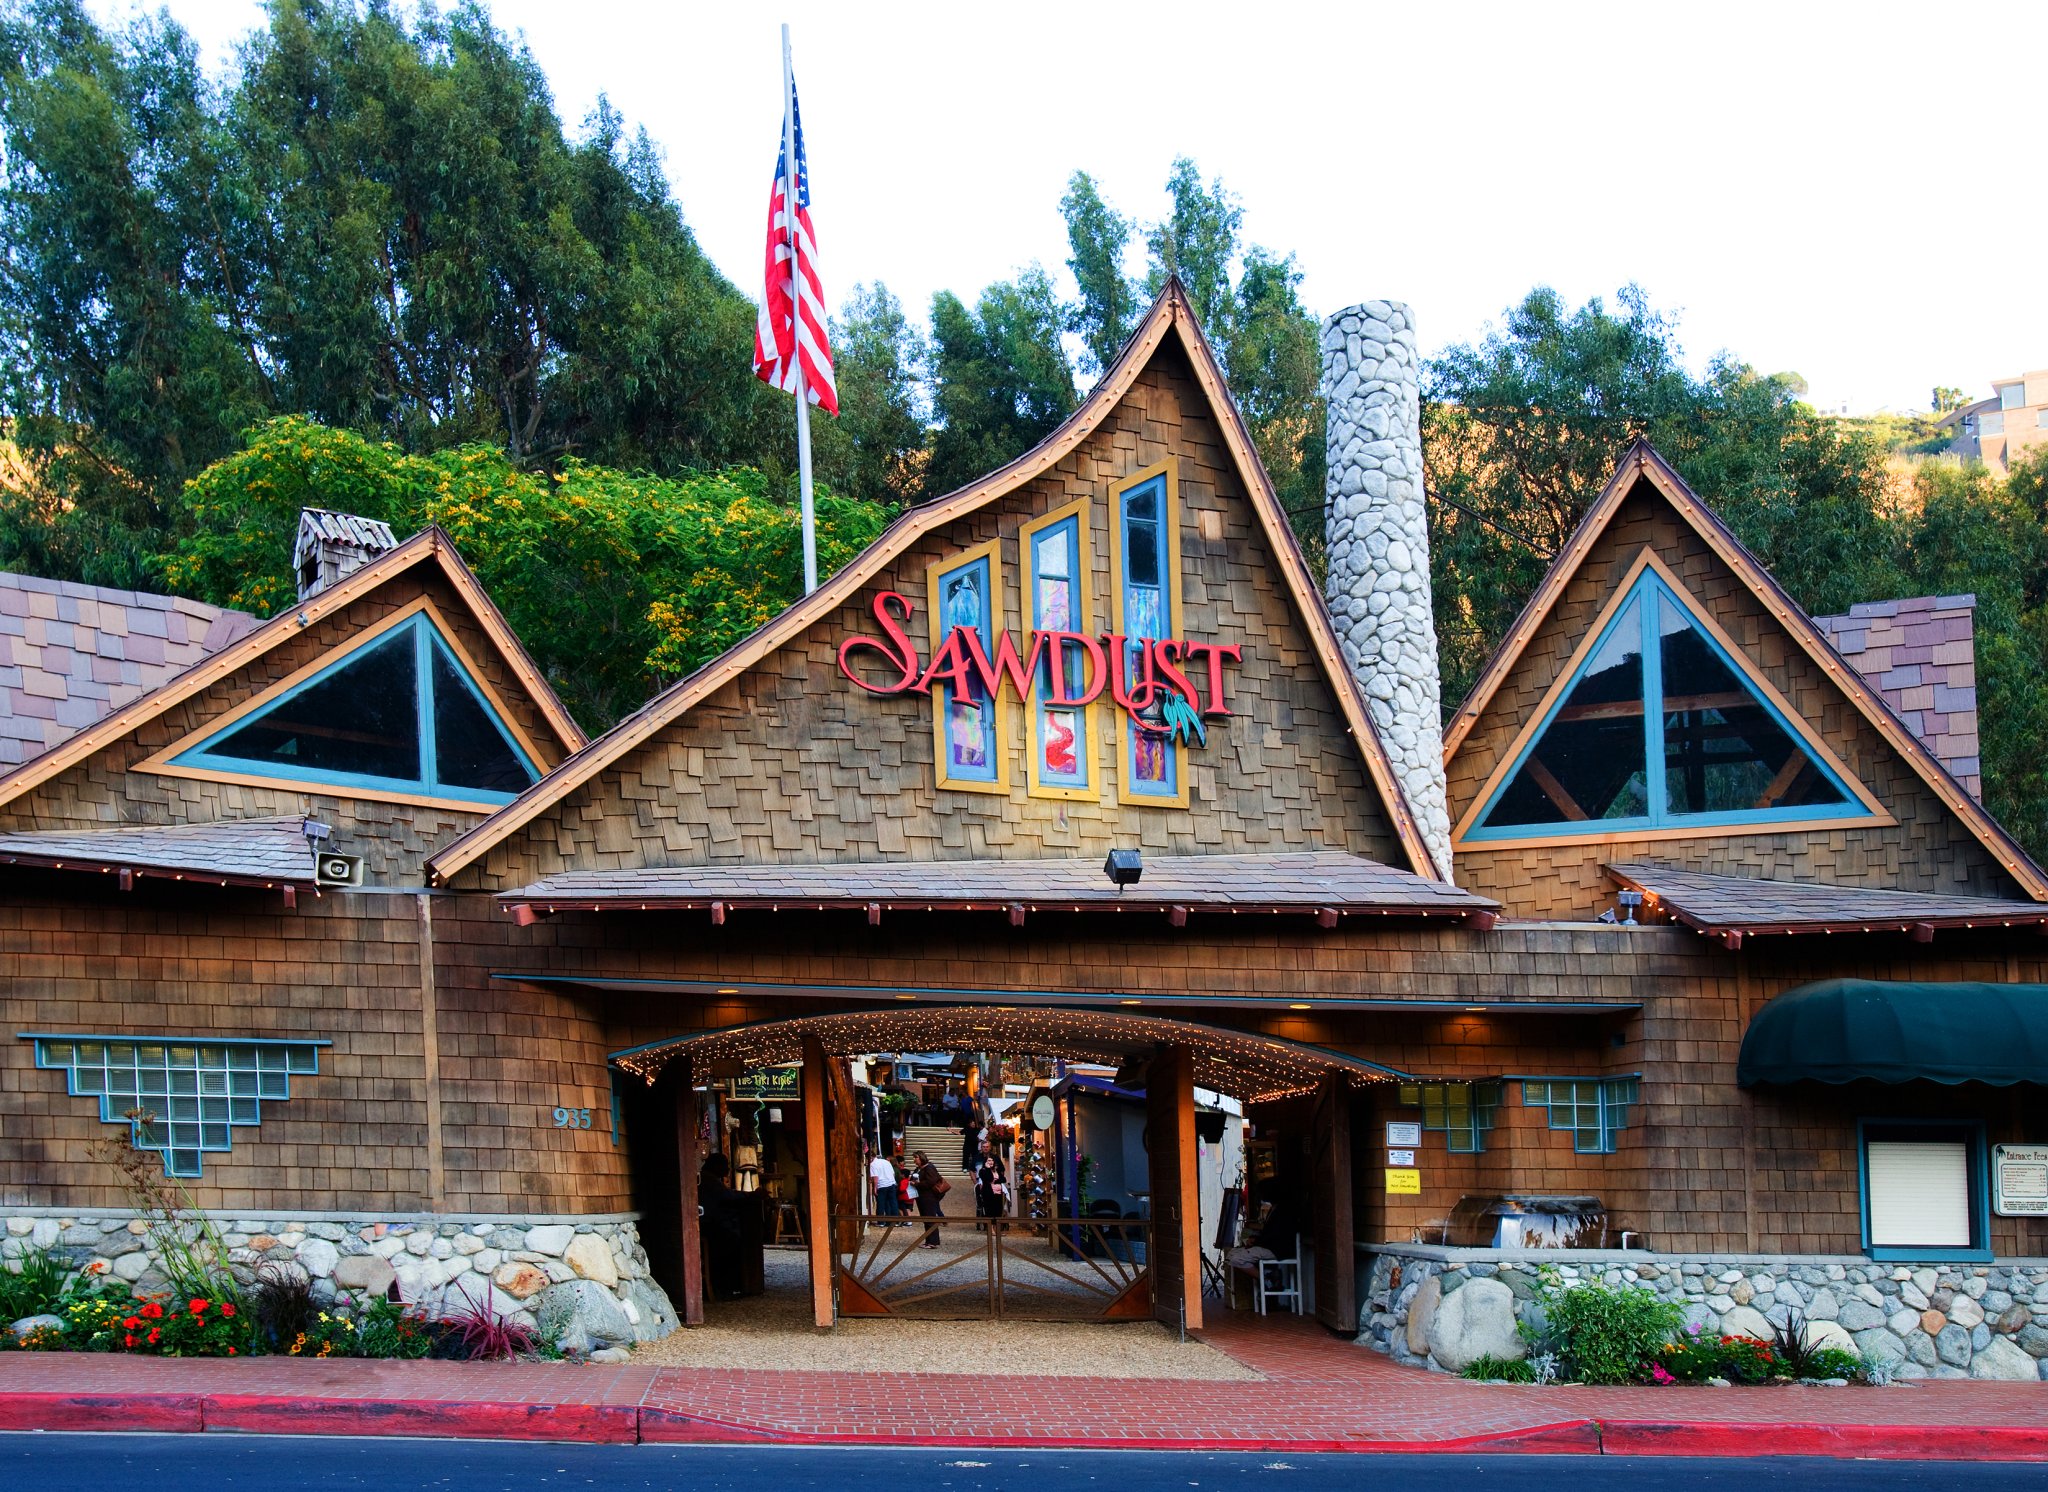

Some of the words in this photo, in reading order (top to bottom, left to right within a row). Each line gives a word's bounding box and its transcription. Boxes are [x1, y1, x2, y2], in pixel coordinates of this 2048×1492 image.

[838, 591, 1243, 732] SAWDUST
[751, 1075, 769, 1085] TIKI
[772, 1075, 793, 1085] KING
[553, 1107, 592, 1129] 935
[2007, 1151, 2031, 1161] Entrance
[2035, 1151, 2048, 1161] Fees
